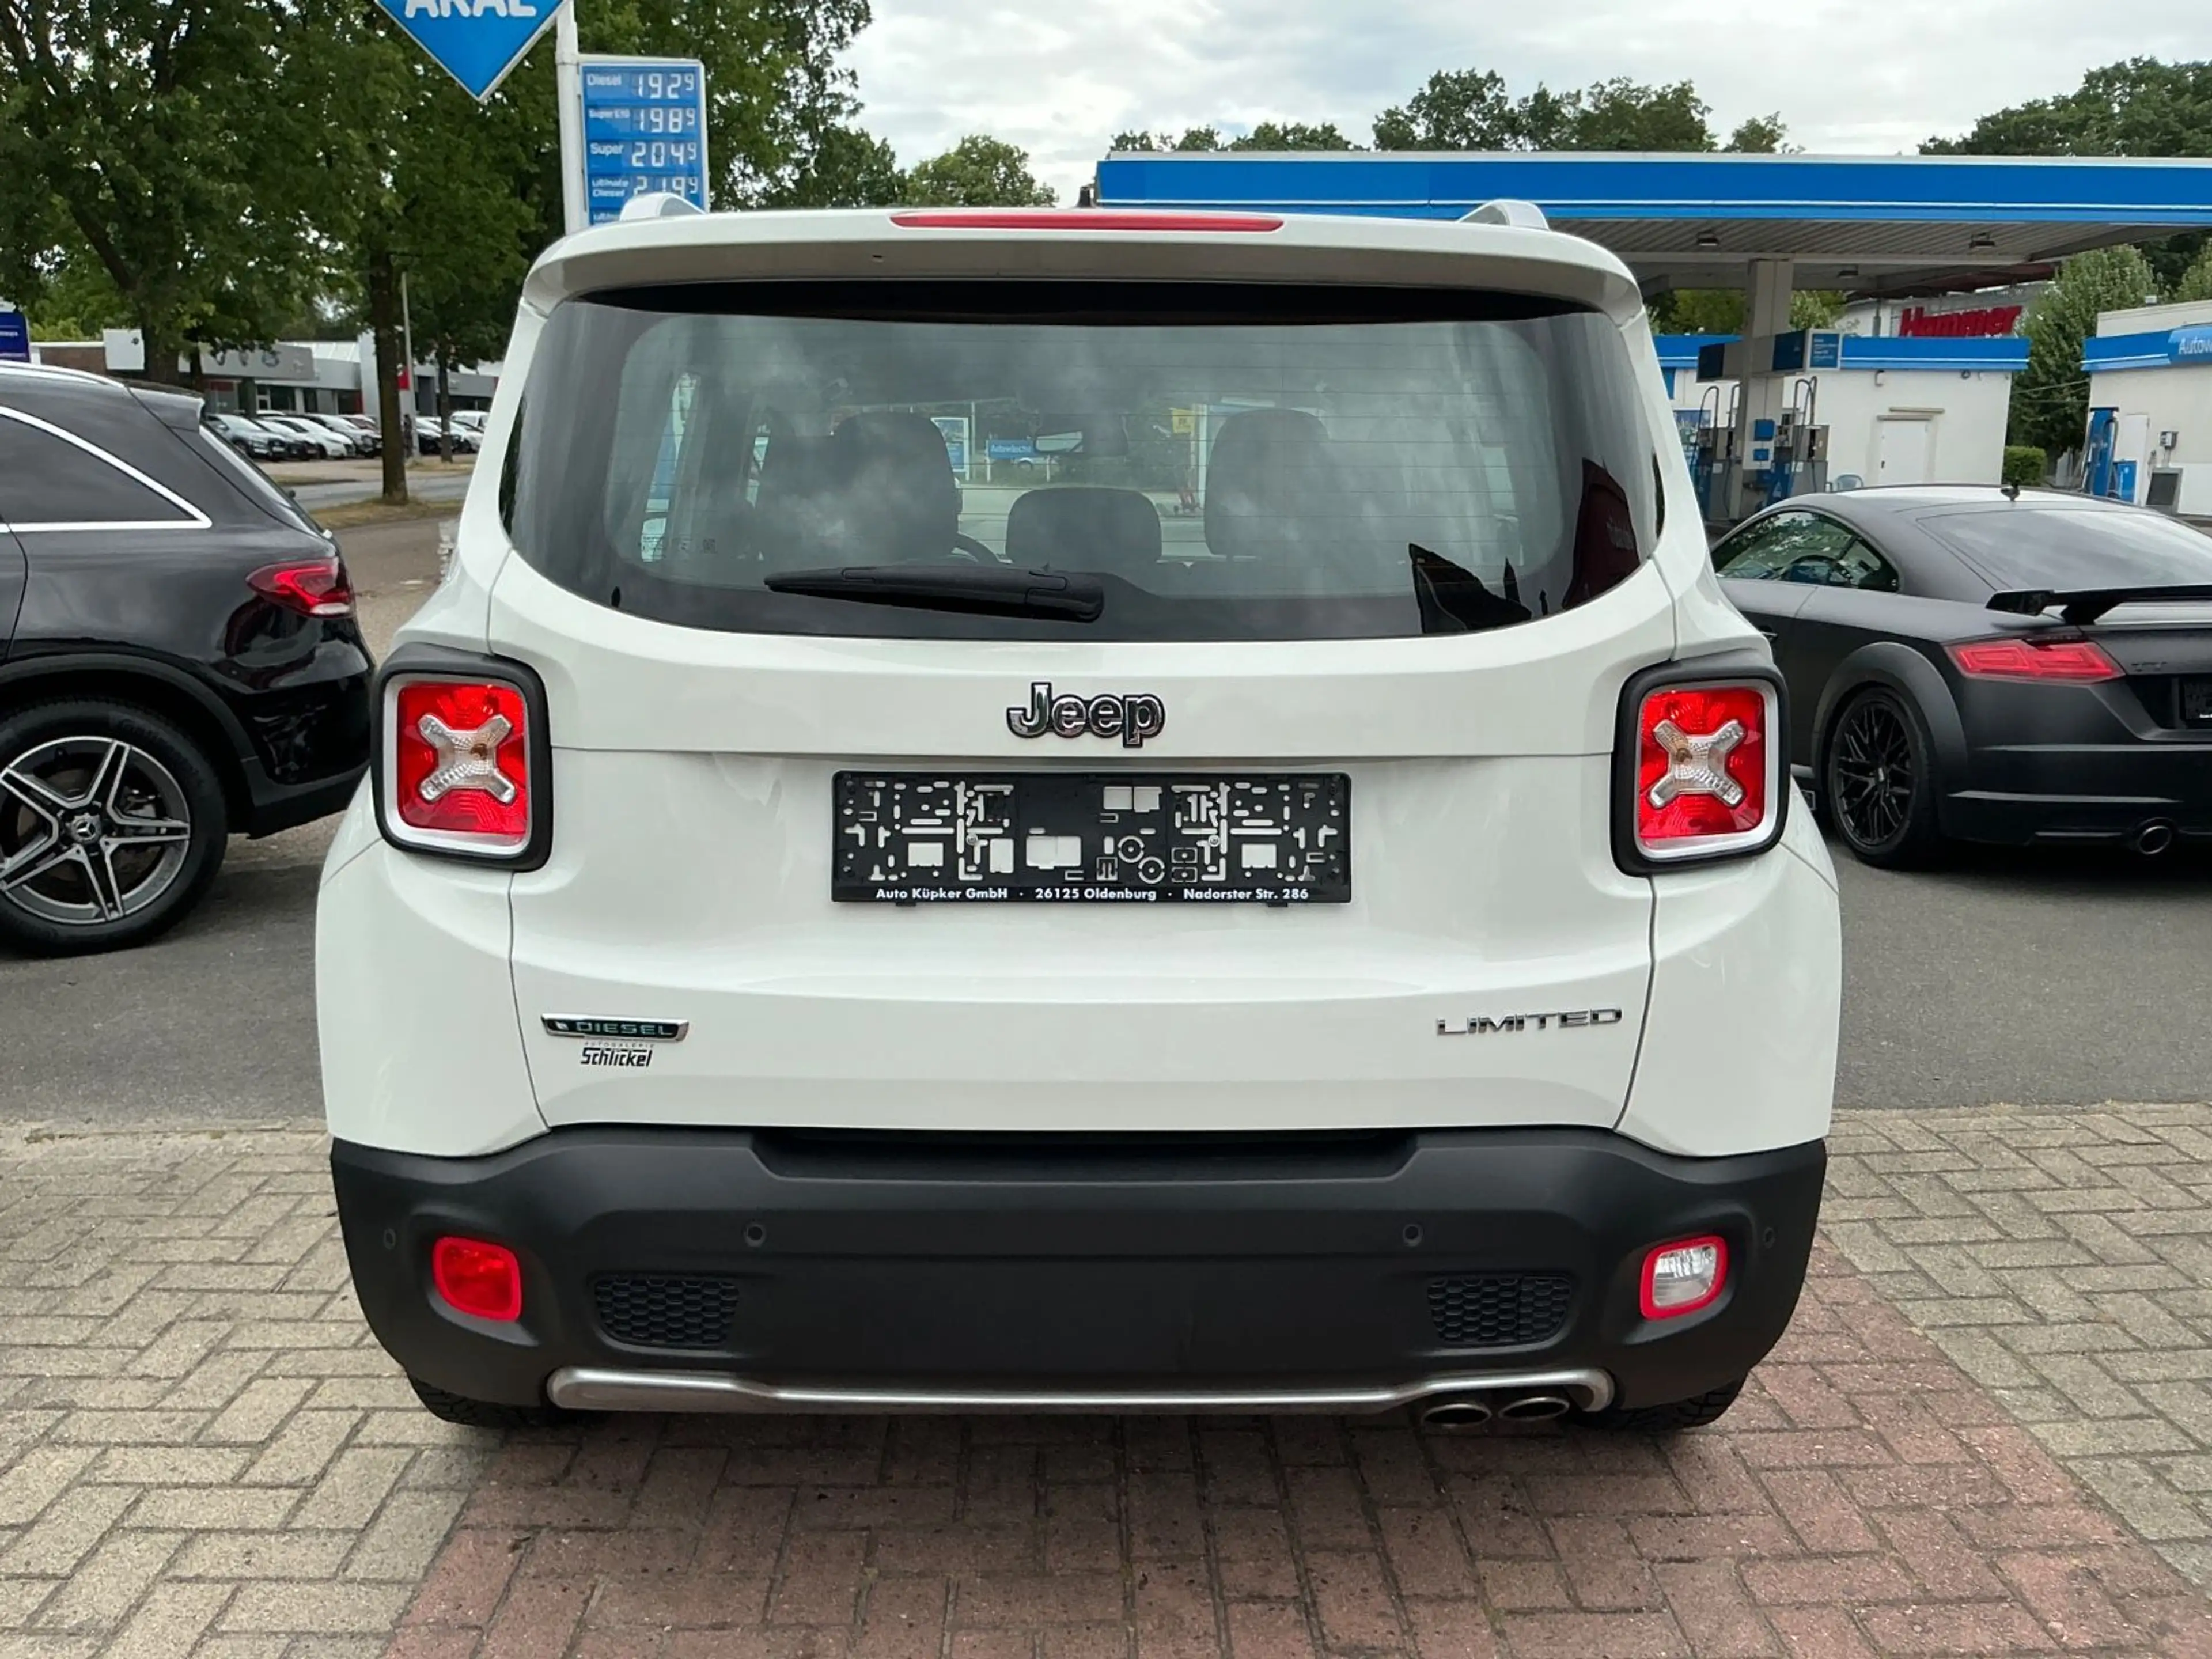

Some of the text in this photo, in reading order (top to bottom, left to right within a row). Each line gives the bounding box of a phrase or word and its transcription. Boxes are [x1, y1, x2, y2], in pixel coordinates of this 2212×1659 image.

[586, 74, 622, 85] Diesel
[590, 143, 624, 156] Super
[592, 188, 625, 198] Diesel
[1899, 305, 2022, 336] Hammer
[1006, 682, 1166, 748] Jeep
[876, 888, 1309, 901] Auto Küpker GmbH 26125 Oldenburg Nadorster Str. 286
[576, 1021, 674, 1035] DIESEL
[1437, 1007, 1622, 1036] LIMITED
[581, 1047, 653, 1067] Schlickel
